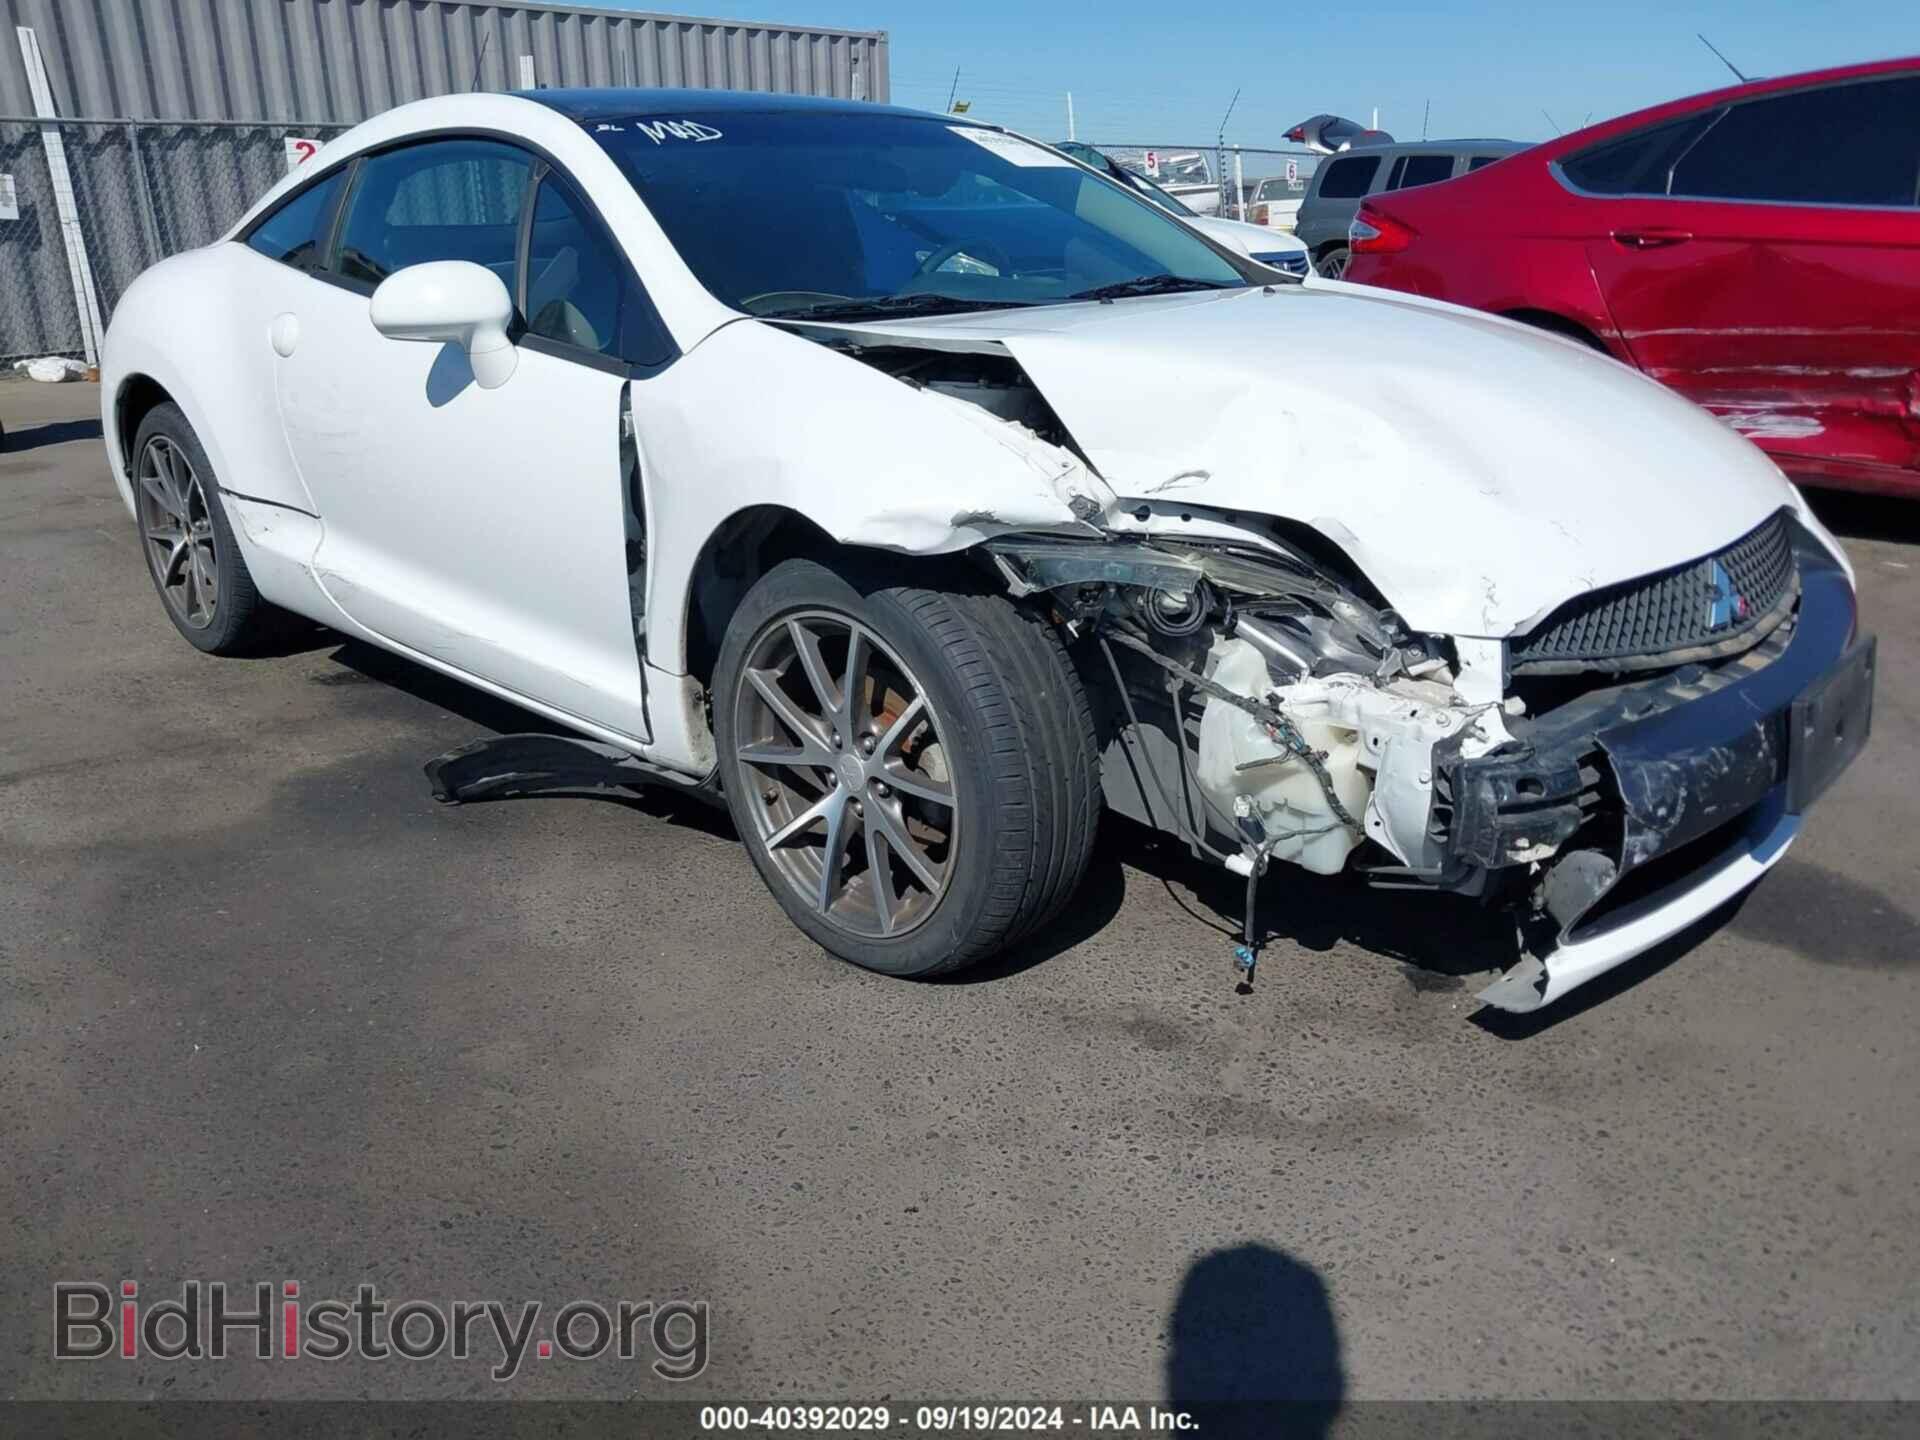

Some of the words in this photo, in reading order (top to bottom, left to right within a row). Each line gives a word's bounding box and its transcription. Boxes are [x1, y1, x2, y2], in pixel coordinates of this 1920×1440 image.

[635, 119, 723, 145] MAD
[295, 141, 316, 166] 2
[1147, 152, 1155, 169] 5
